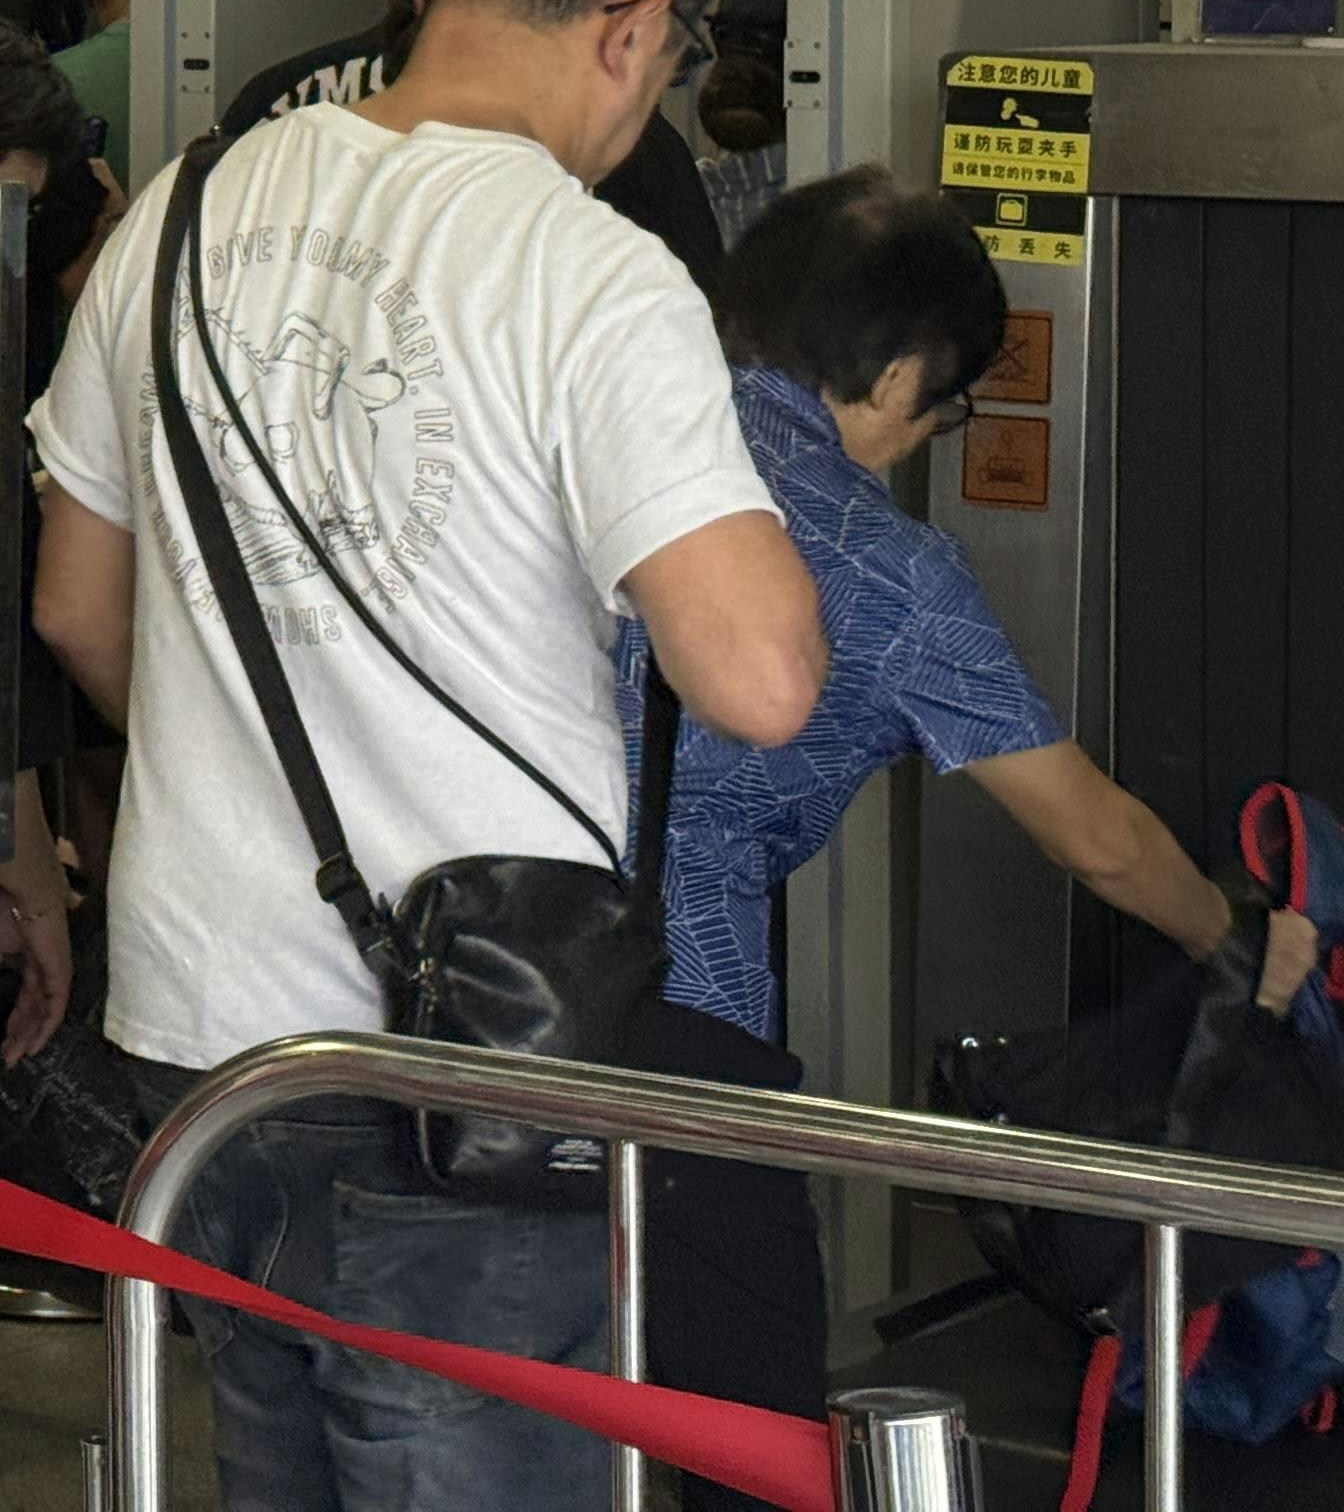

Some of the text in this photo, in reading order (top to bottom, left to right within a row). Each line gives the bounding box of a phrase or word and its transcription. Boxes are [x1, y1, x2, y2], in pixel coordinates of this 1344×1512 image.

[958, 62, 1082, 89] 注意您的儿童
[953, 132, 1078, 159] 谨防玩耍夹手
[952, 162, 1076, 185] 请保管您的行李物品
[207, 227, 273, 280] GIVE
[413, 407, 454, 443] IN
